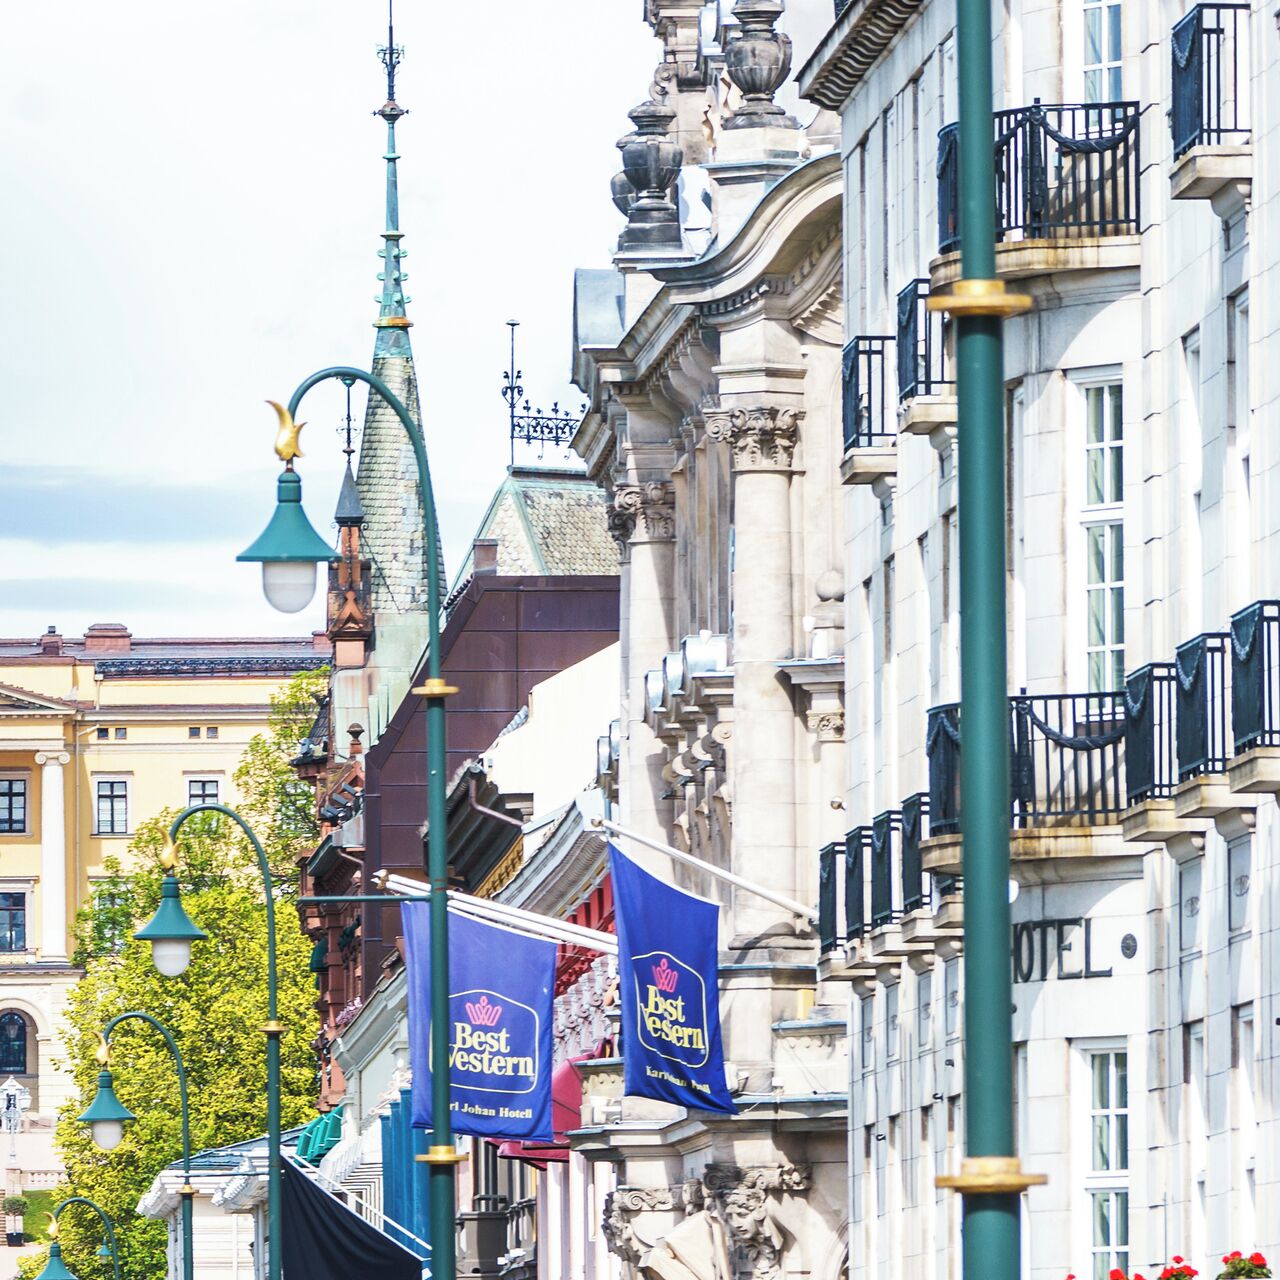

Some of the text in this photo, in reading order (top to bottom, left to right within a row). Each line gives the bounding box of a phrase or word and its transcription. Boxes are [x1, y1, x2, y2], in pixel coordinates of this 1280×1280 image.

[454, 1022, 510, 1053] Best
[461, 1103, 496, 1117] Johan
[498, 1106, 533, 1119] Hotell
